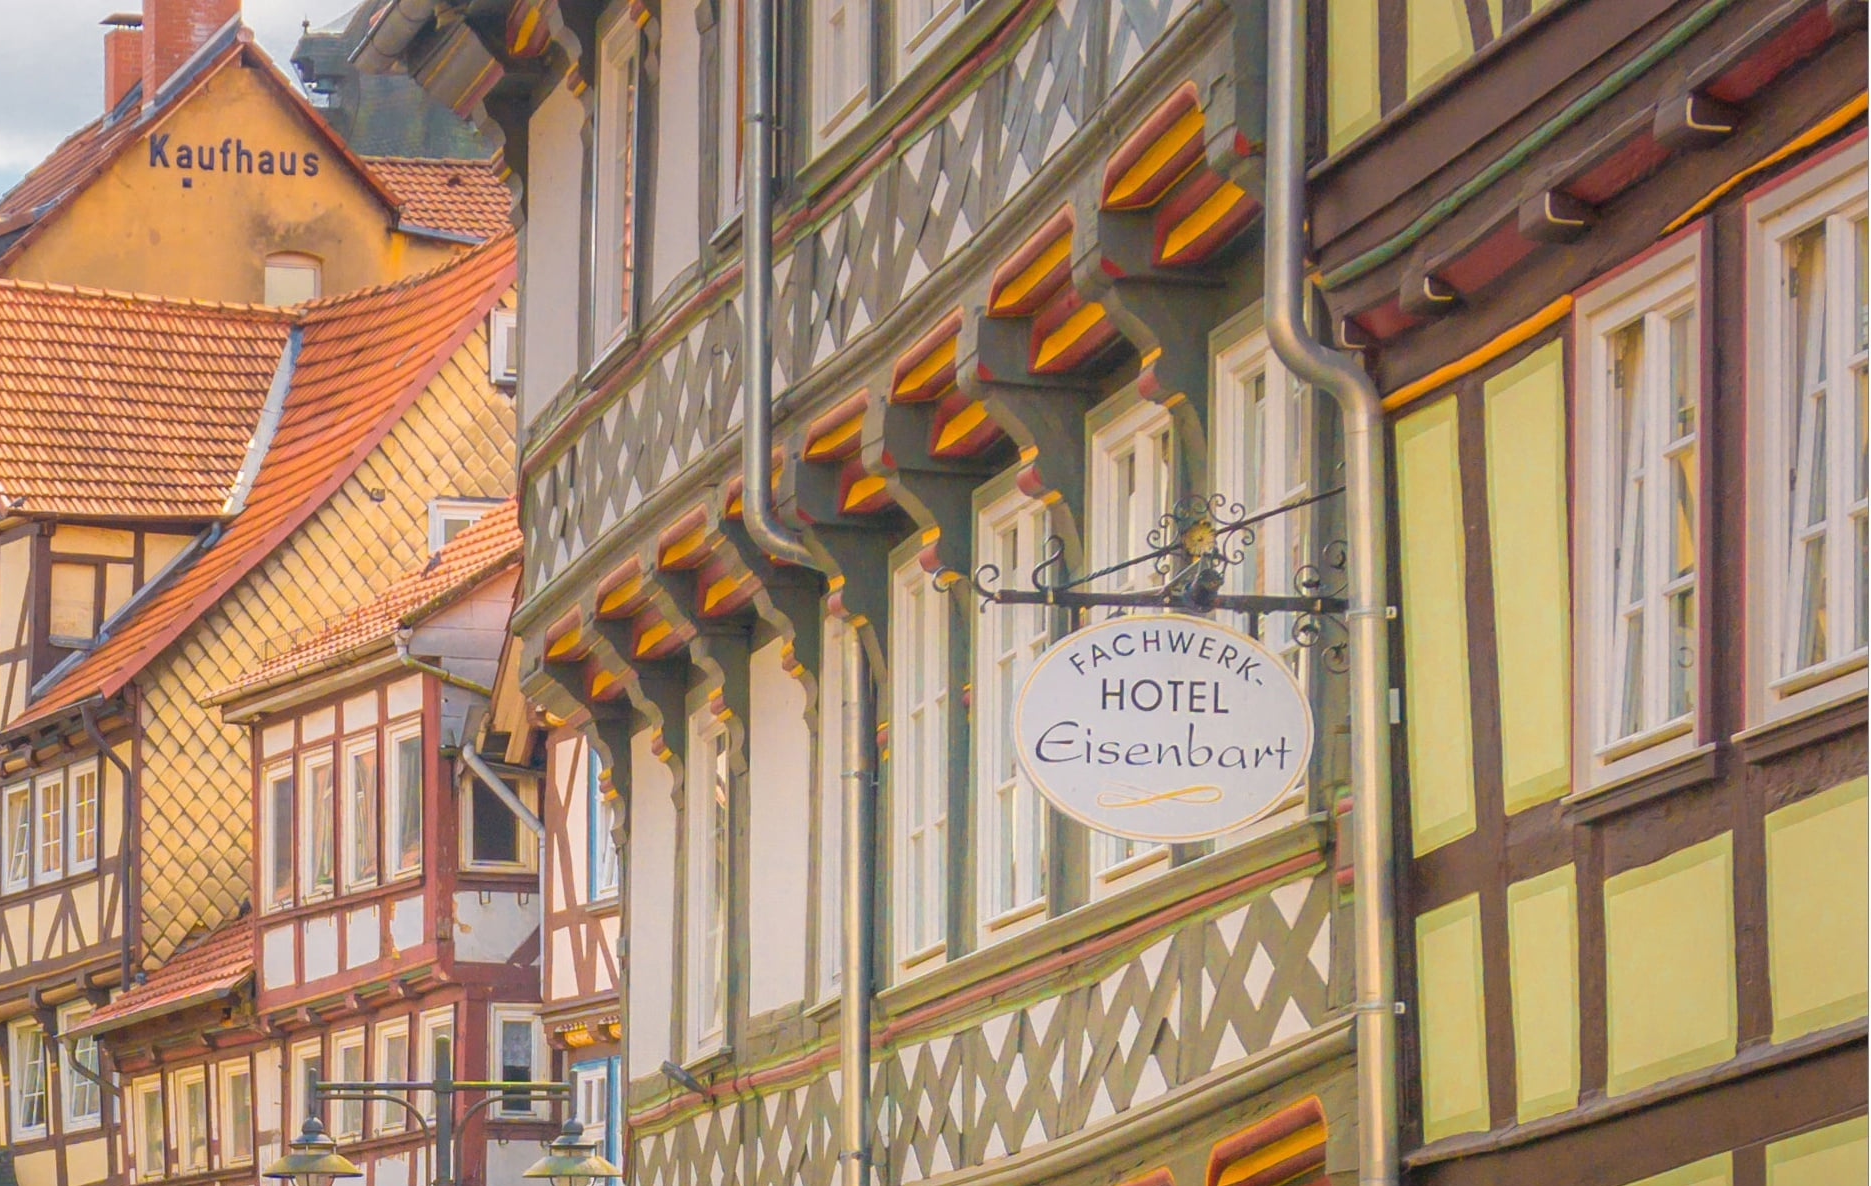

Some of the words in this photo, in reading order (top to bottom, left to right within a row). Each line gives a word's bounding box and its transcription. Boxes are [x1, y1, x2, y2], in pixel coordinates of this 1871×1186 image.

[149, 133, 320, 177] Kaufhaus
[1068, 629, 1265, 687] FACHWERK-
[1101, 678, 1229, 714] HOTEL
[1035, 721, 1293, 770] Eisenbart
